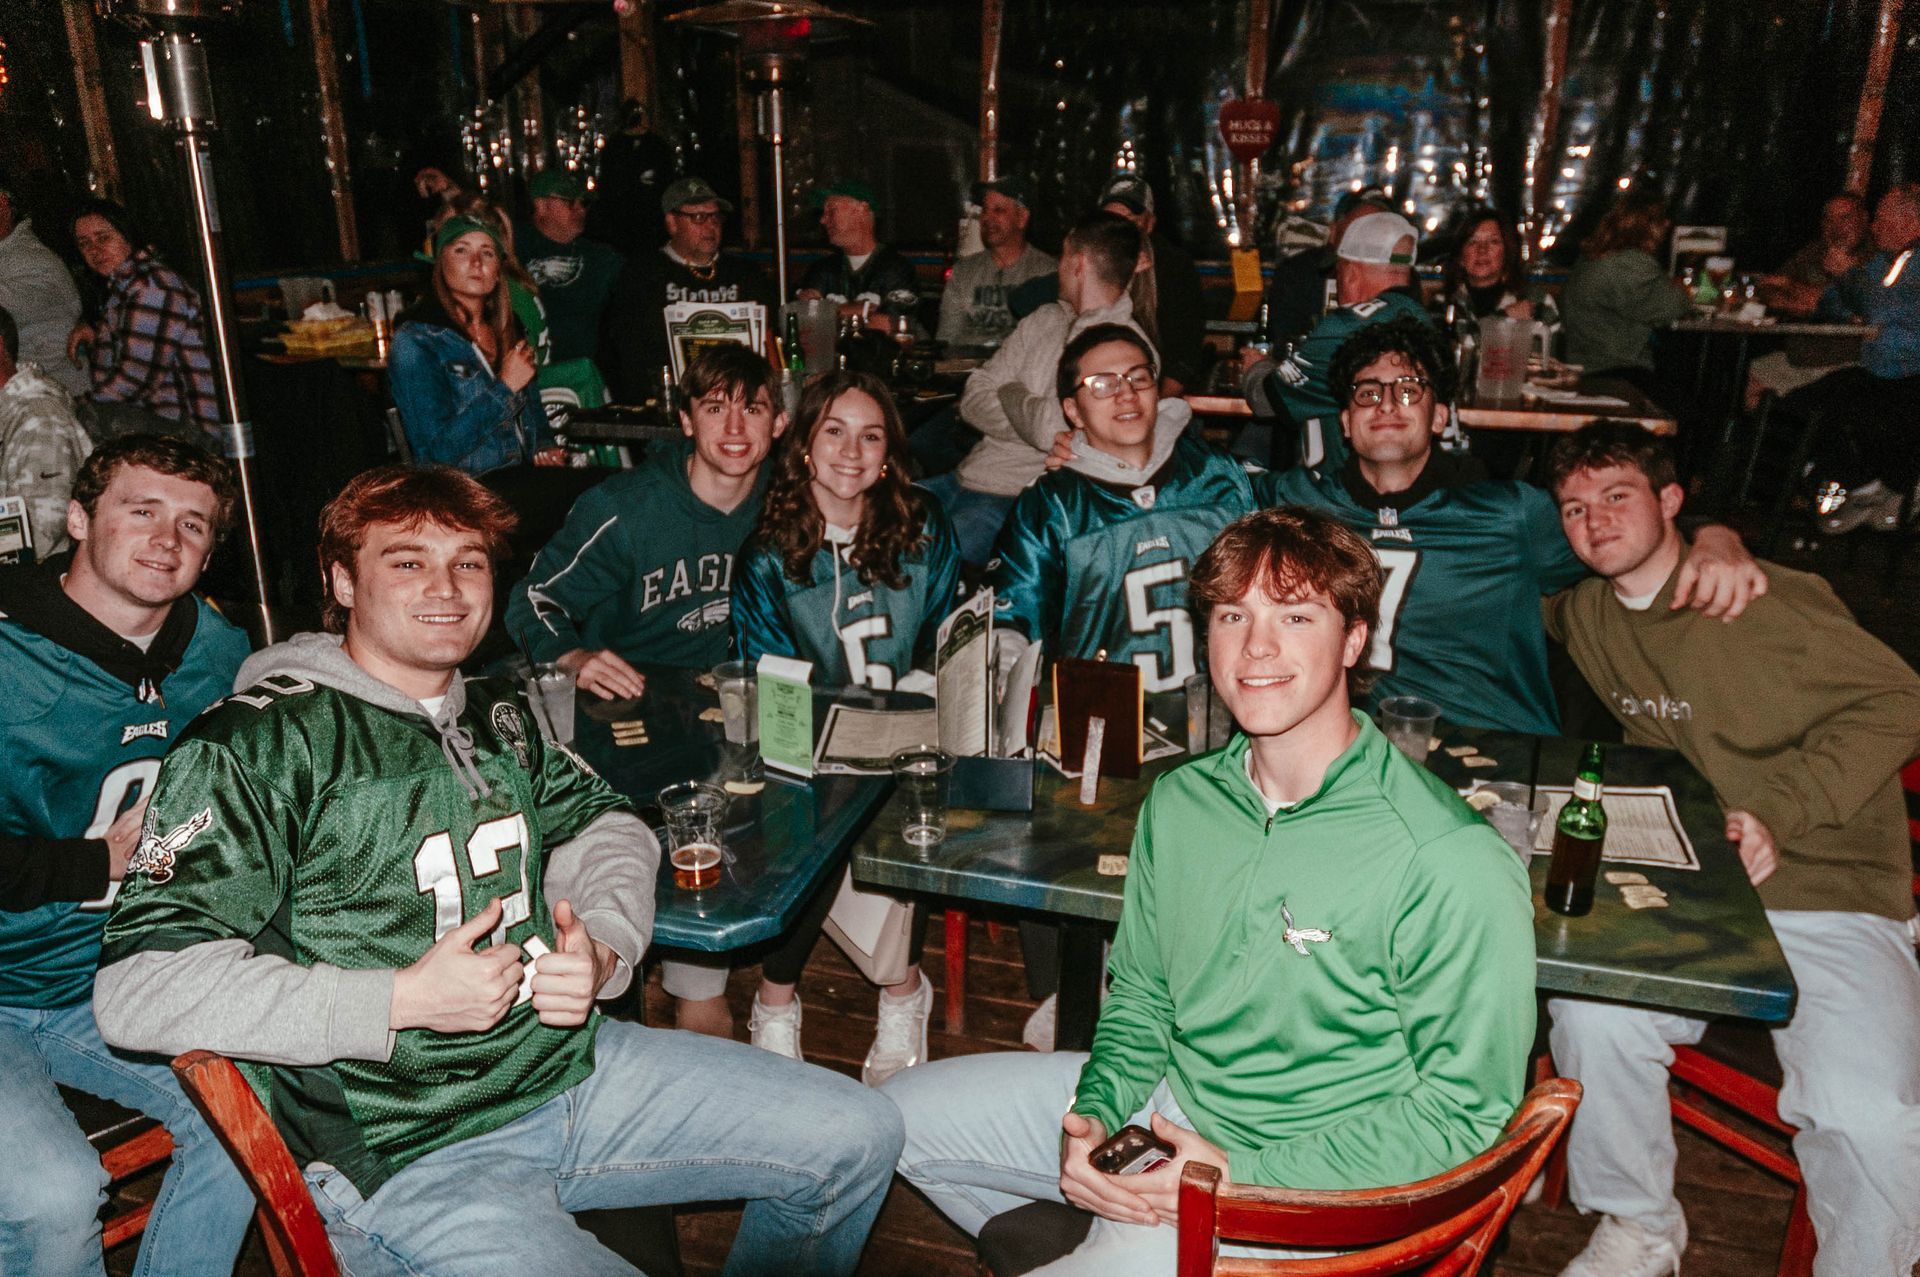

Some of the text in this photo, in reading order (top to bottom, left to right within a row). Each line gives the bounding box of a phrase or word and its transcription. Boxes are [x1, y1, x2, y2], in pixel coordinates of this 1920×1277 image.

[640, 553, 734, 613] EAGL
[1124, 559, 1196, 693] 5
[121, 720, 168, 744] EAGLES
